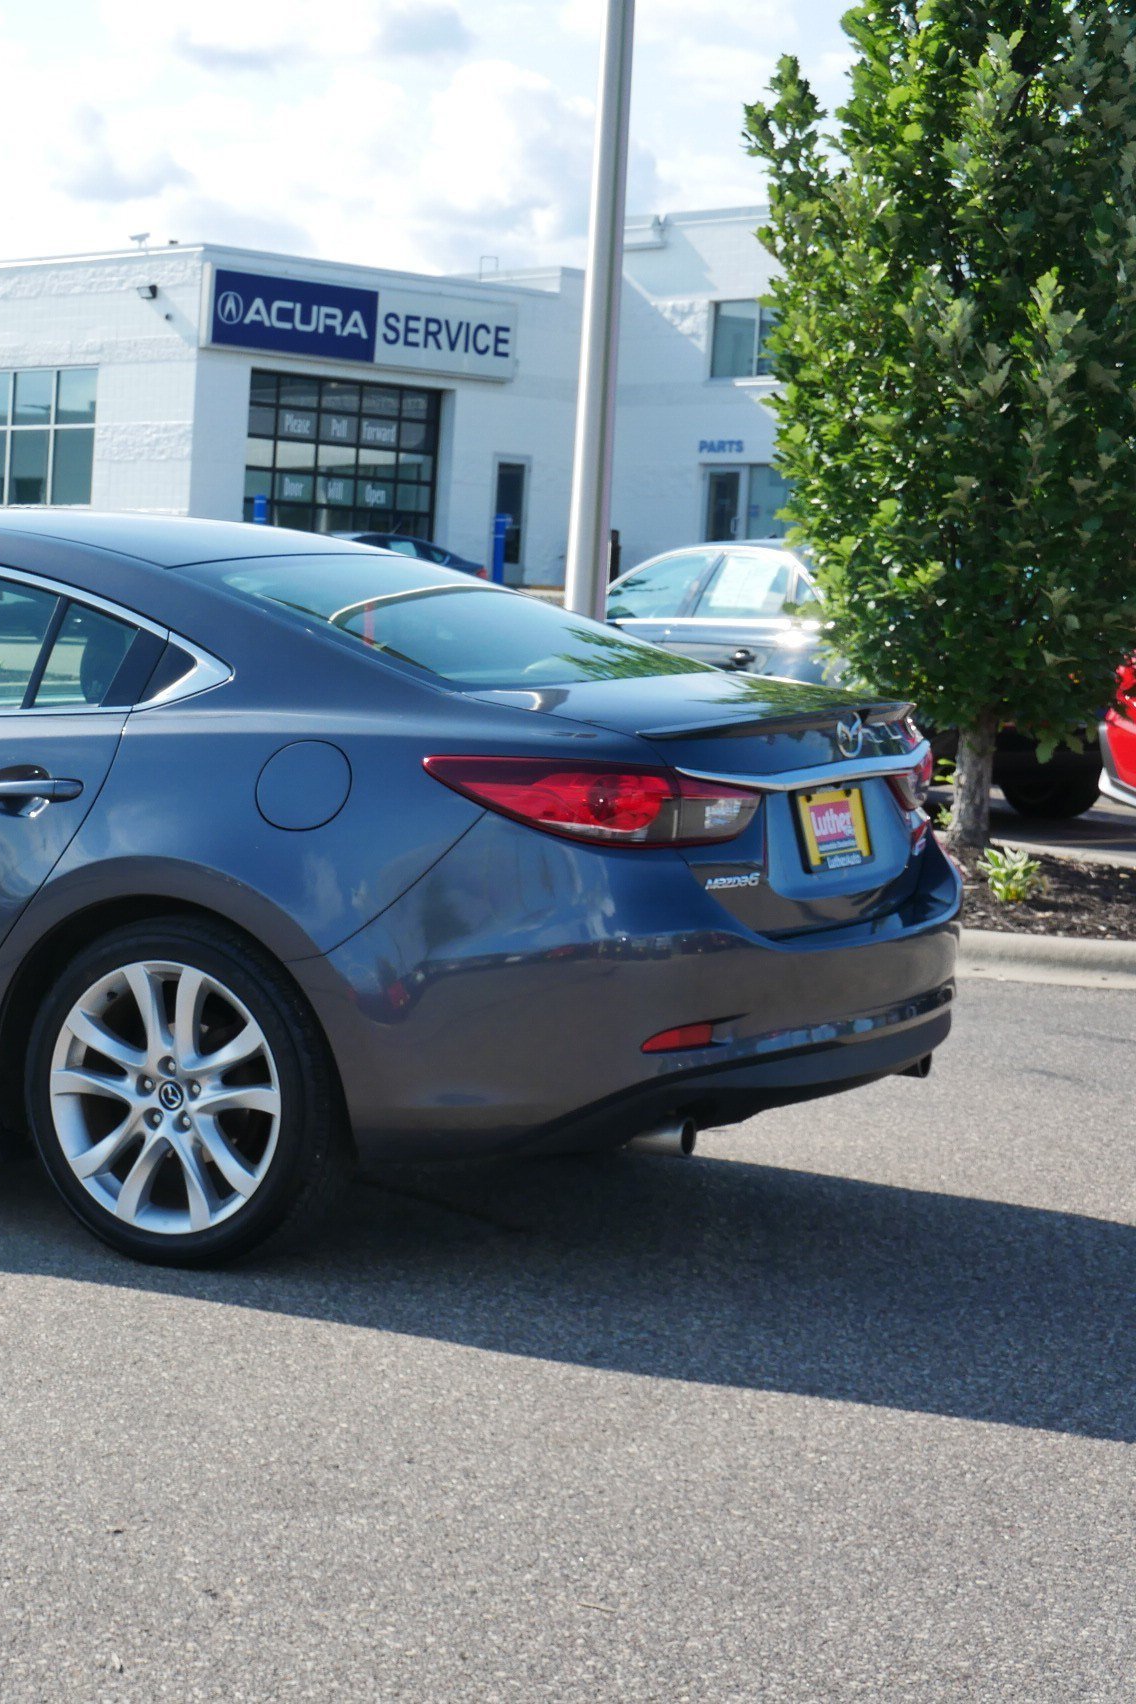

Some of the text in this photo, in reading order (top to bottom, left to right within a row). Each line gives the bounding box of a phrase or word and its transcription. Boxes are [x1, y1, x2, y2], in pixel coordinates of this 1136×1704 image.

[243, 297, 511, 358] ACURA SERVICE
[284, 413, 397, 443] Please Pull Forward
[698, 440, 744, 453] PARTS
[284, 477, 304, 497] Door
[365, 484, 386, 507] Open
[810, 808, 852, 837] Luther
